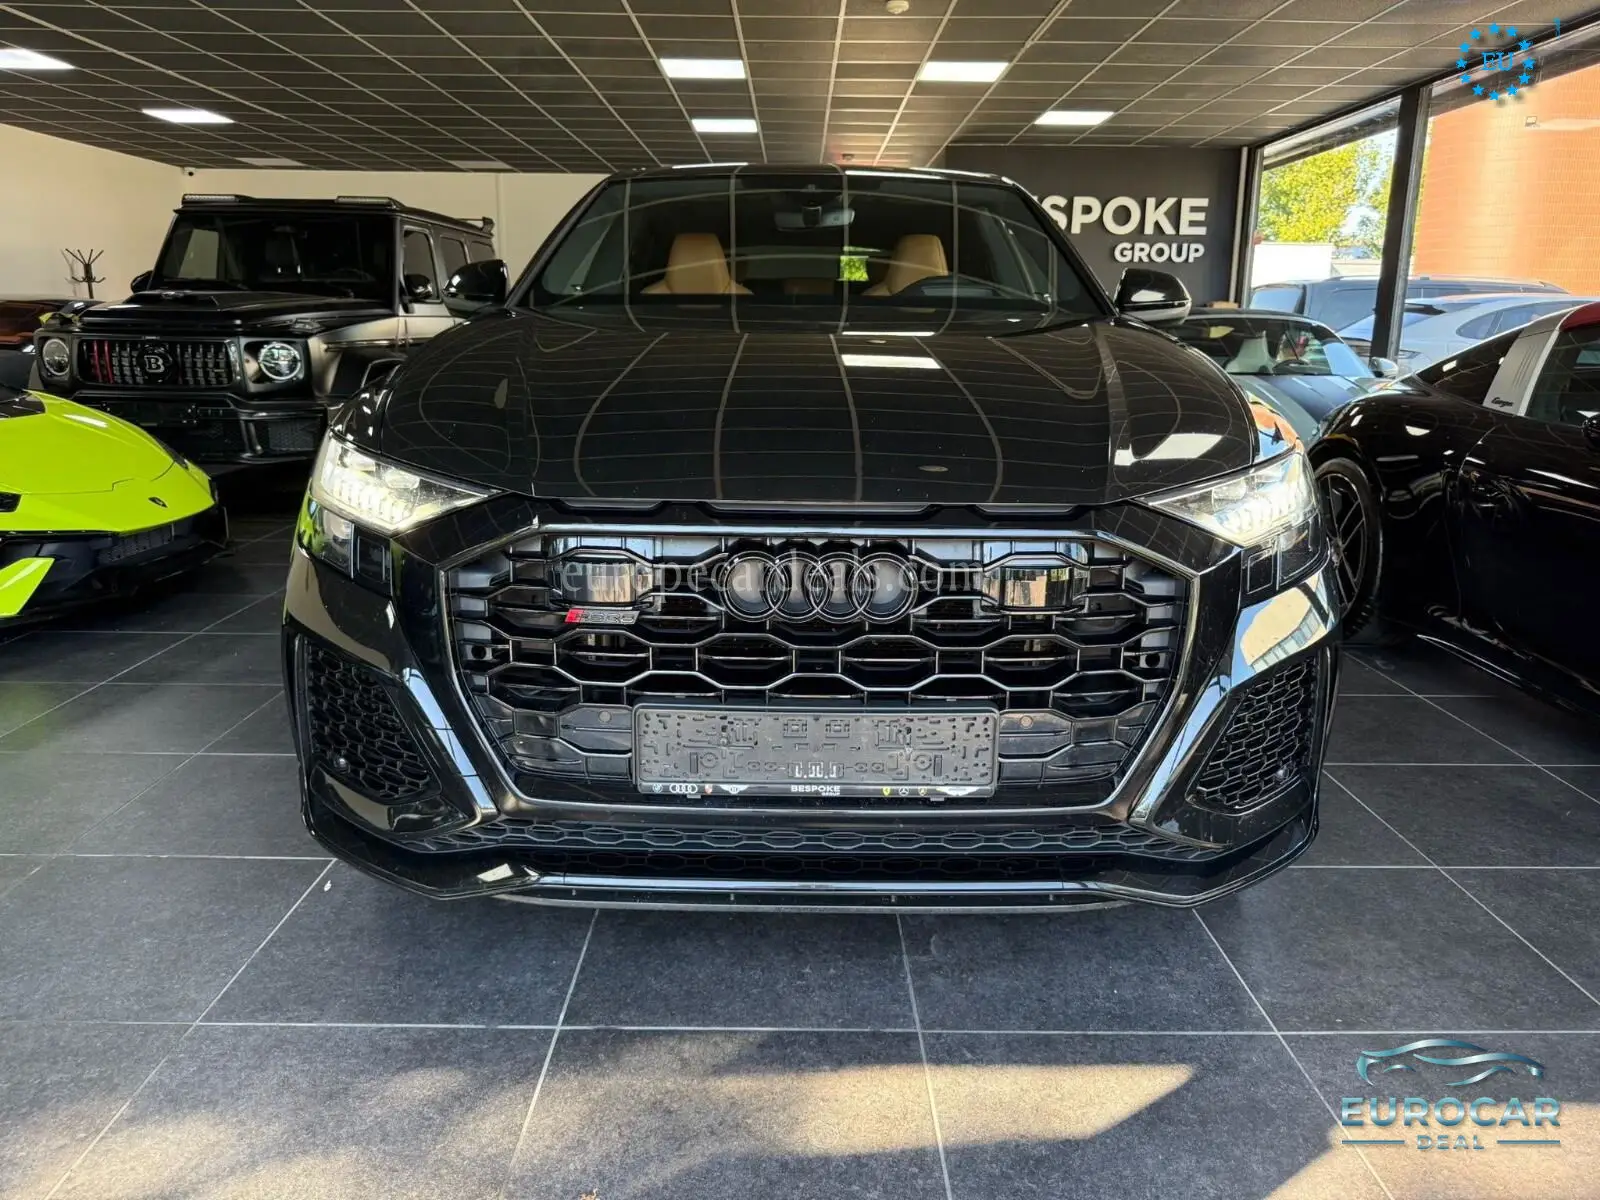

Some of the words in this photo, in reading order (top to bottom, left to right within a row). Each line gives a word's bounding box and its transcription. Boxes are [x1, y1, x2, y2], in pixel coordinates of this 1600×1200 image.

[1034, 195, 1210, 236] SPOKE
[1113, 242, 1205, 264] GROUP
[790, 784, 841, 793] BESPOKE
